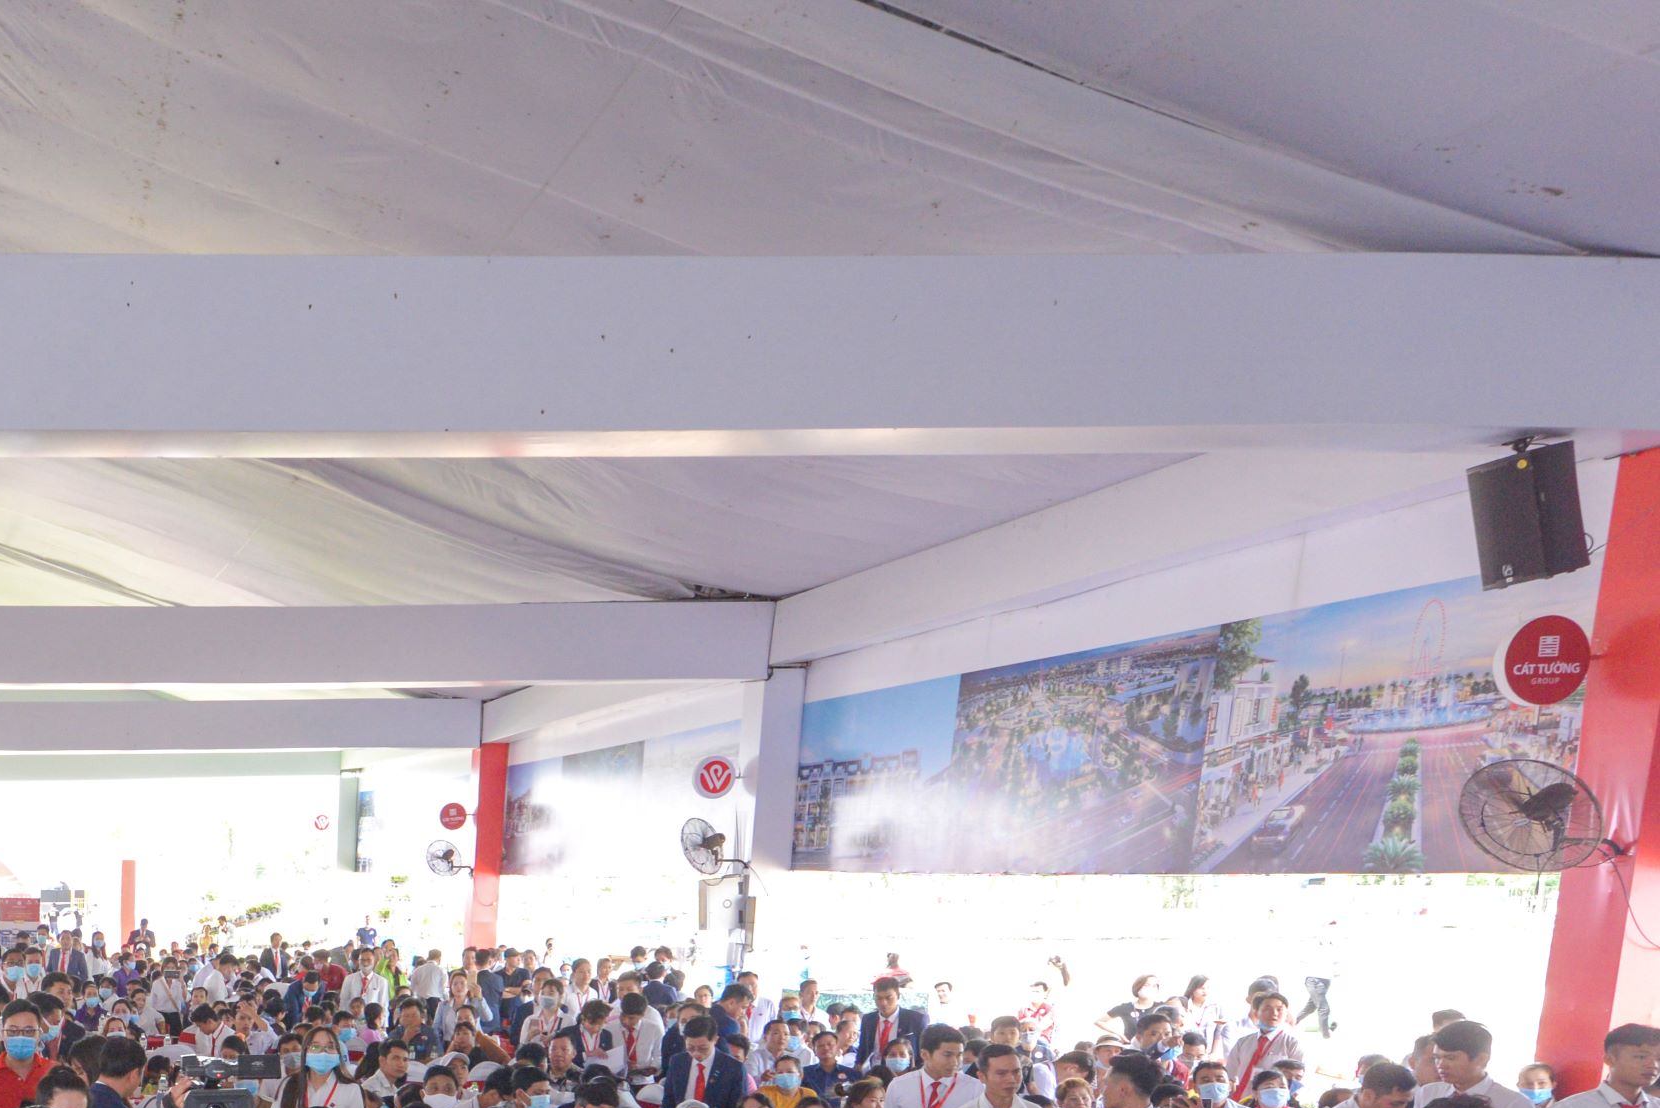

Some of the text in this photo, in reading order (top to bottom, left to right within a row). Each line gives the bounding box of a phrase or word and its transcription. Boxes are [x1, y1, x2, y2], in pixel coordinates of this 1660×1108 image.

[1513, 661, 1580, 675] CÁT TƯỜNG
[1531, 677, 1560, 685] GROUP
